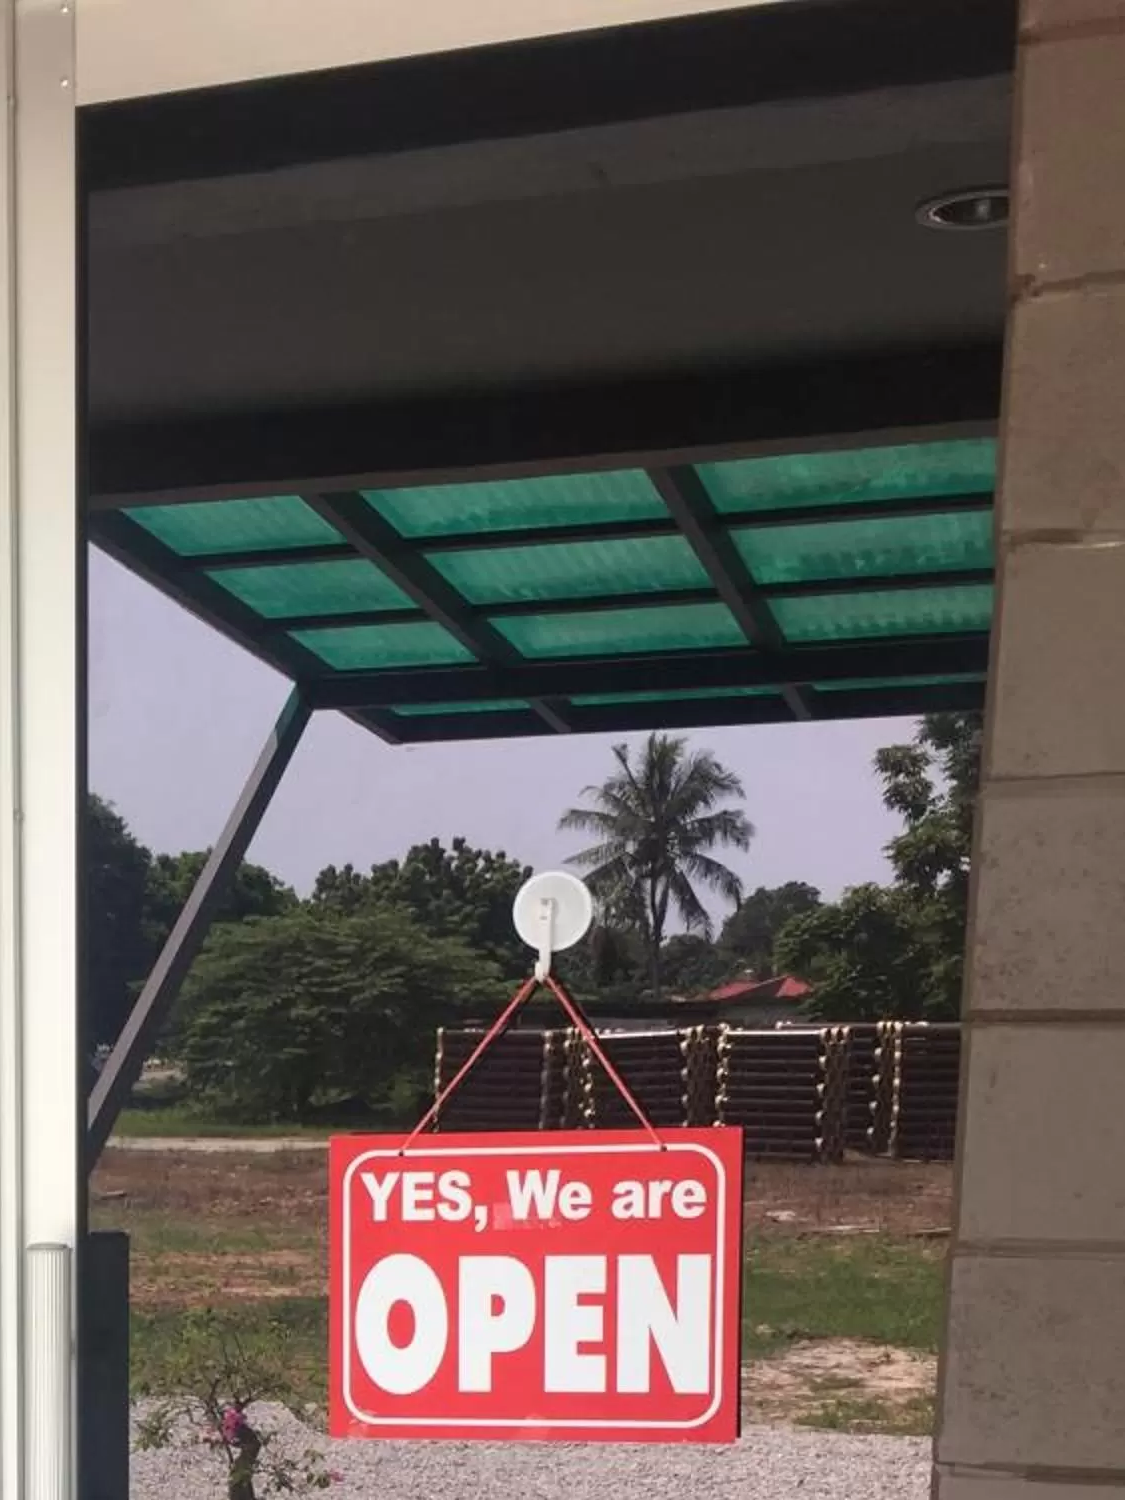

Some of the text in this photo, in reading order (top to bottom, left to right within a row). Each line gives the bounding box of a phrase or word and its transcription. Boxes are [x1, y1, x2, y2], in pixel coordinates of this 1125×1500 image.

[360, 1169, 707, 1232] YES, We are
[355, 1253, 713, 1395] OPEN
